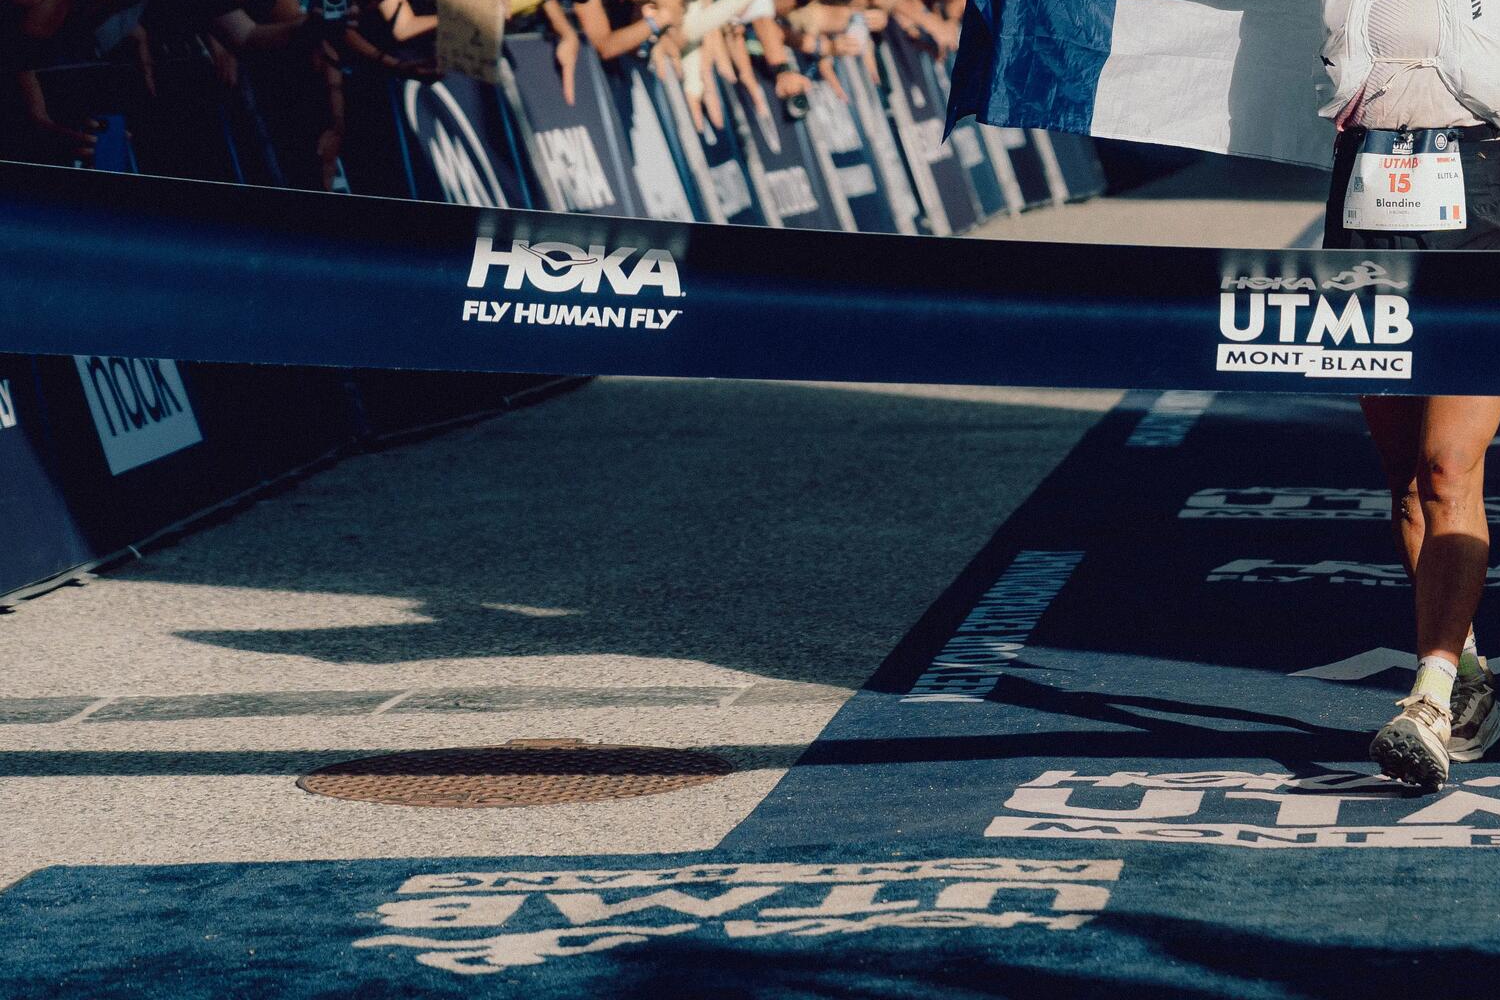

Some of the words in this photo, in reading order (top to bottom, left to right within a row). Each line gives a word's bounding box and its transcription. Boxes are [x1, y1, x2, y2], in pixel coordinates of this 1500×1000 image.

[1383, 157, 1419, 168] UTMB
[1388, 173, 1411, 193] 15
[1376, 199, 1421, 208] Blandine
[467, 237, 682, 297] HOKA
[1220, 276, 1317, 291] HOKA
[462, 300, 511, 322] FLY
[514, 302, 626, 328] HUMAN
[630, 308, 678, 329] FLY
[1219, 292, 1414, 346] UTMB
[377, 881, 1111, 929] UTMB
